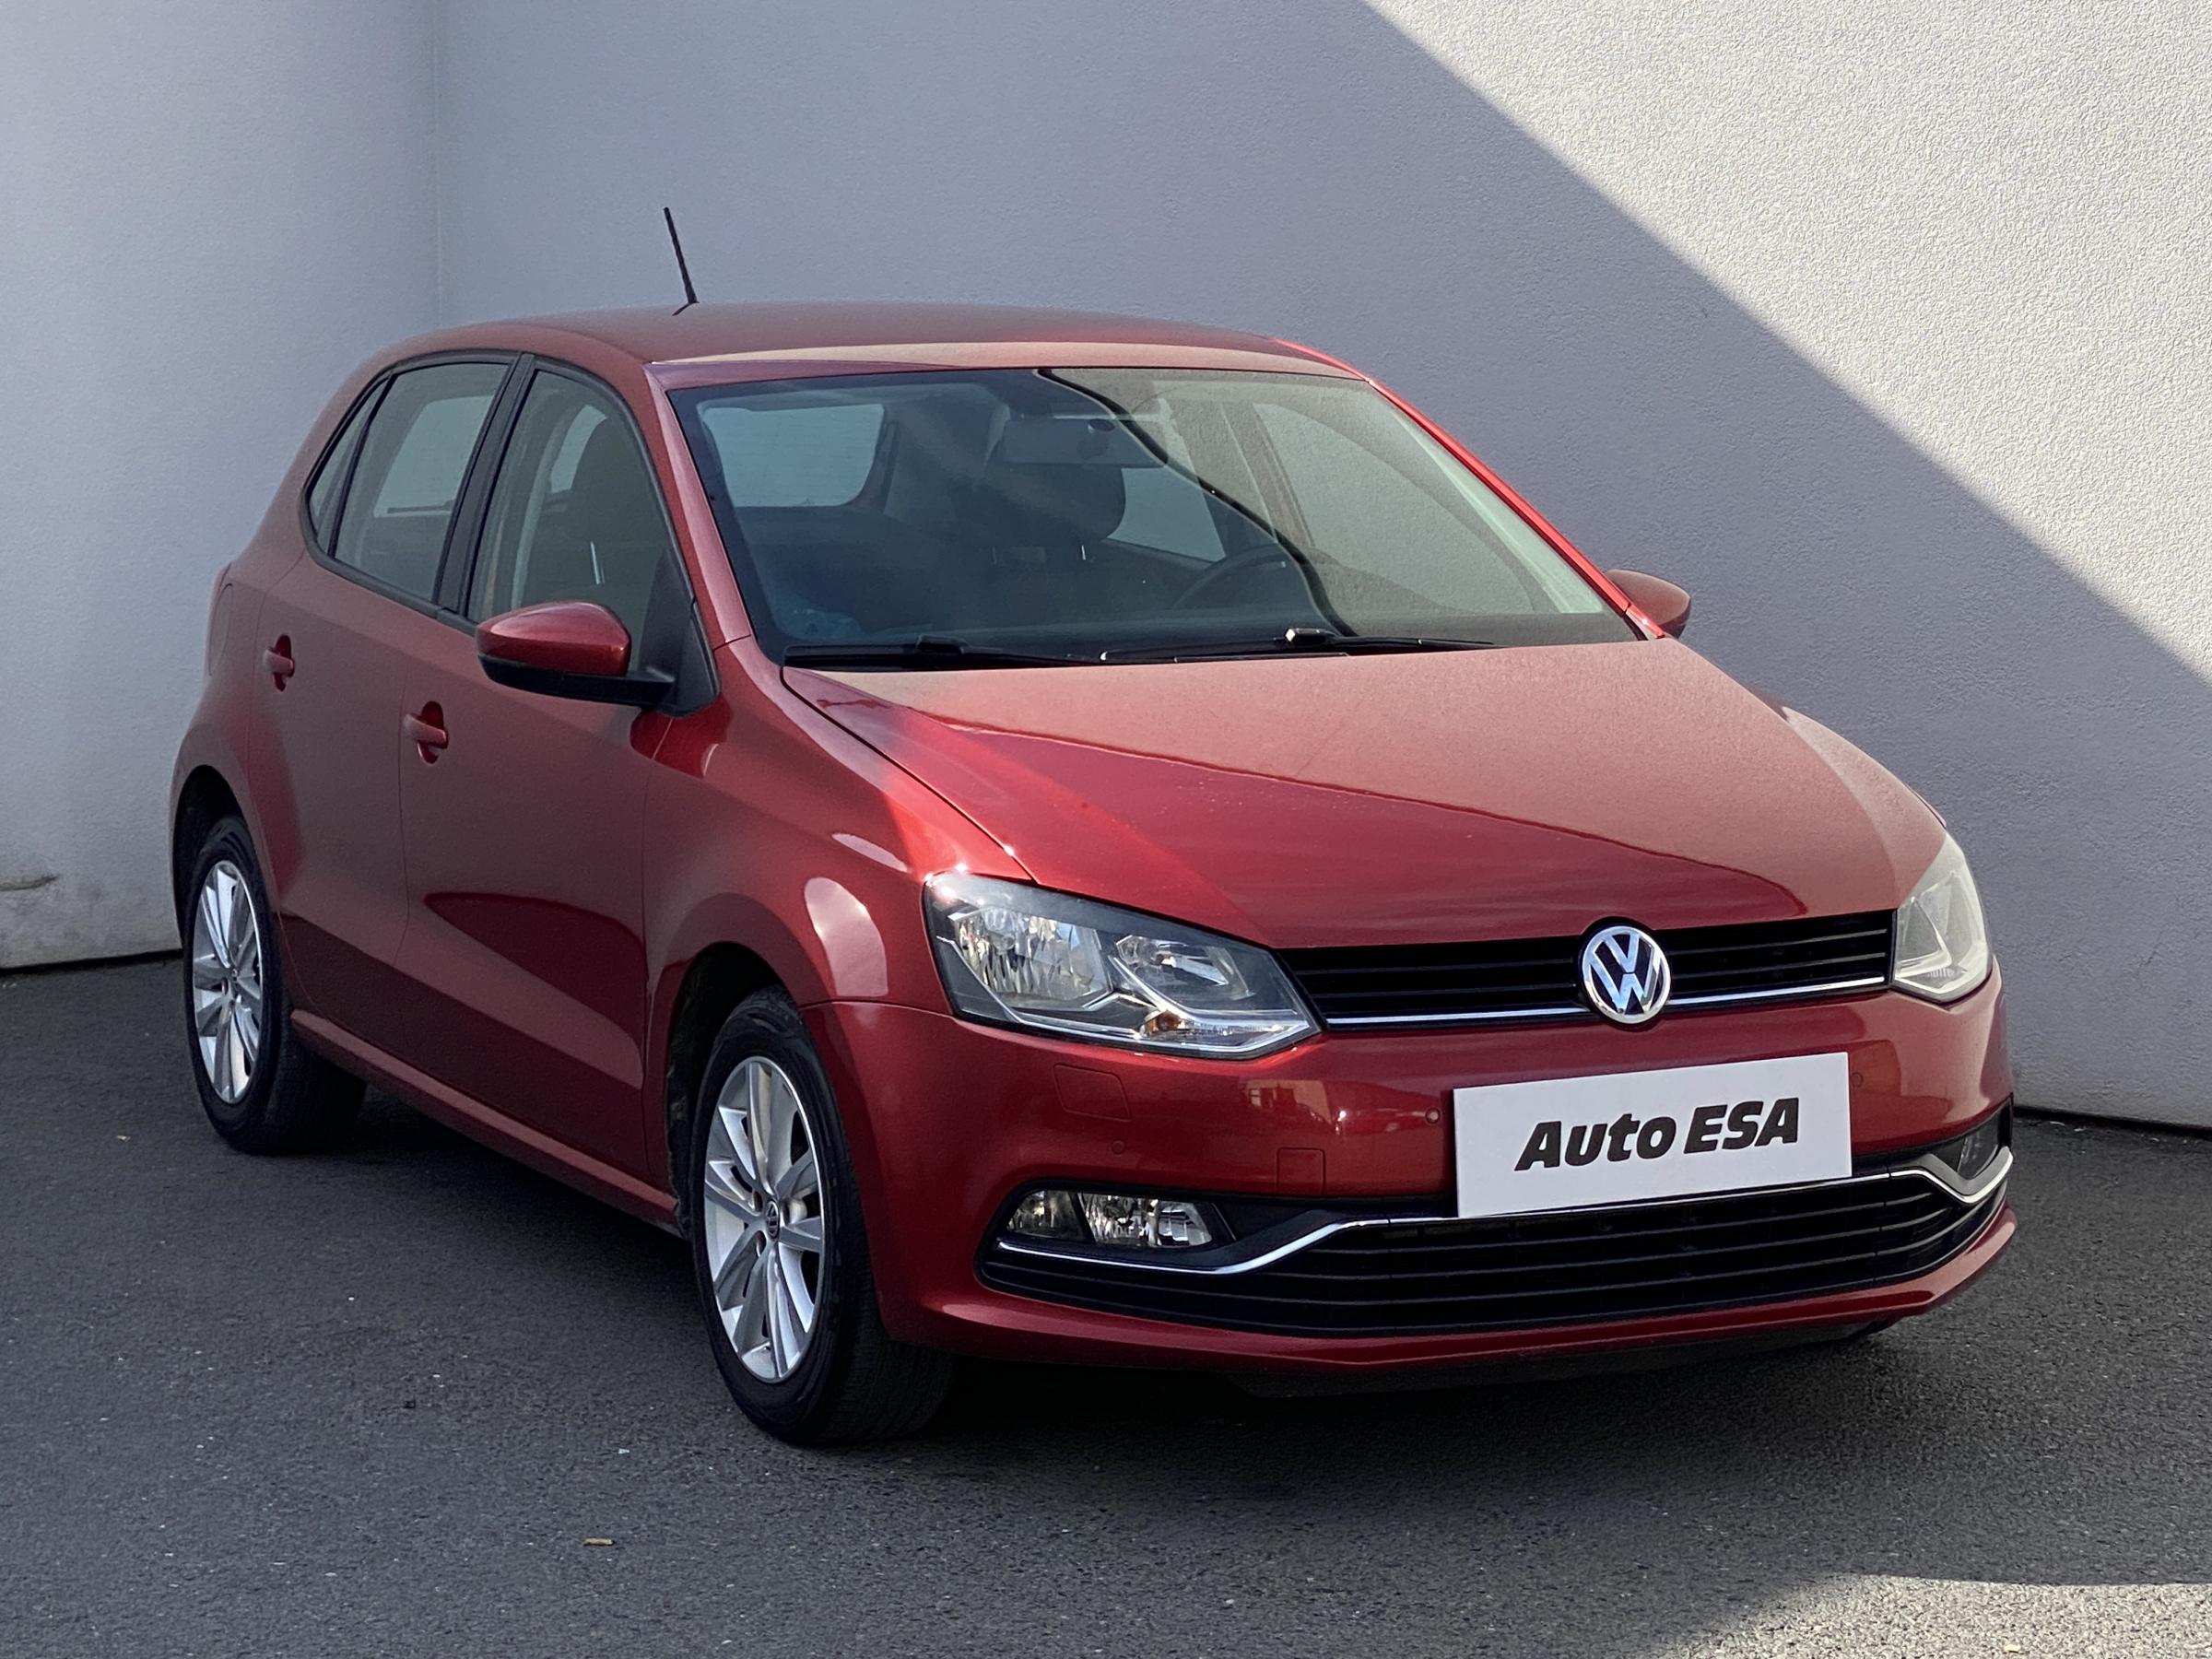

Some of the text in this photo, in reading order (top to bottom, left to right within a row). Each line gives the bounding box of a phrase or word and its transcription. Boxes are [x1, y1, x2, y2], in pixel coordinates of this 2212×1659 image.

[1585, 929, 1664, 1016] VW
[1513, 1097, 1800, 1171] Auto ESA
